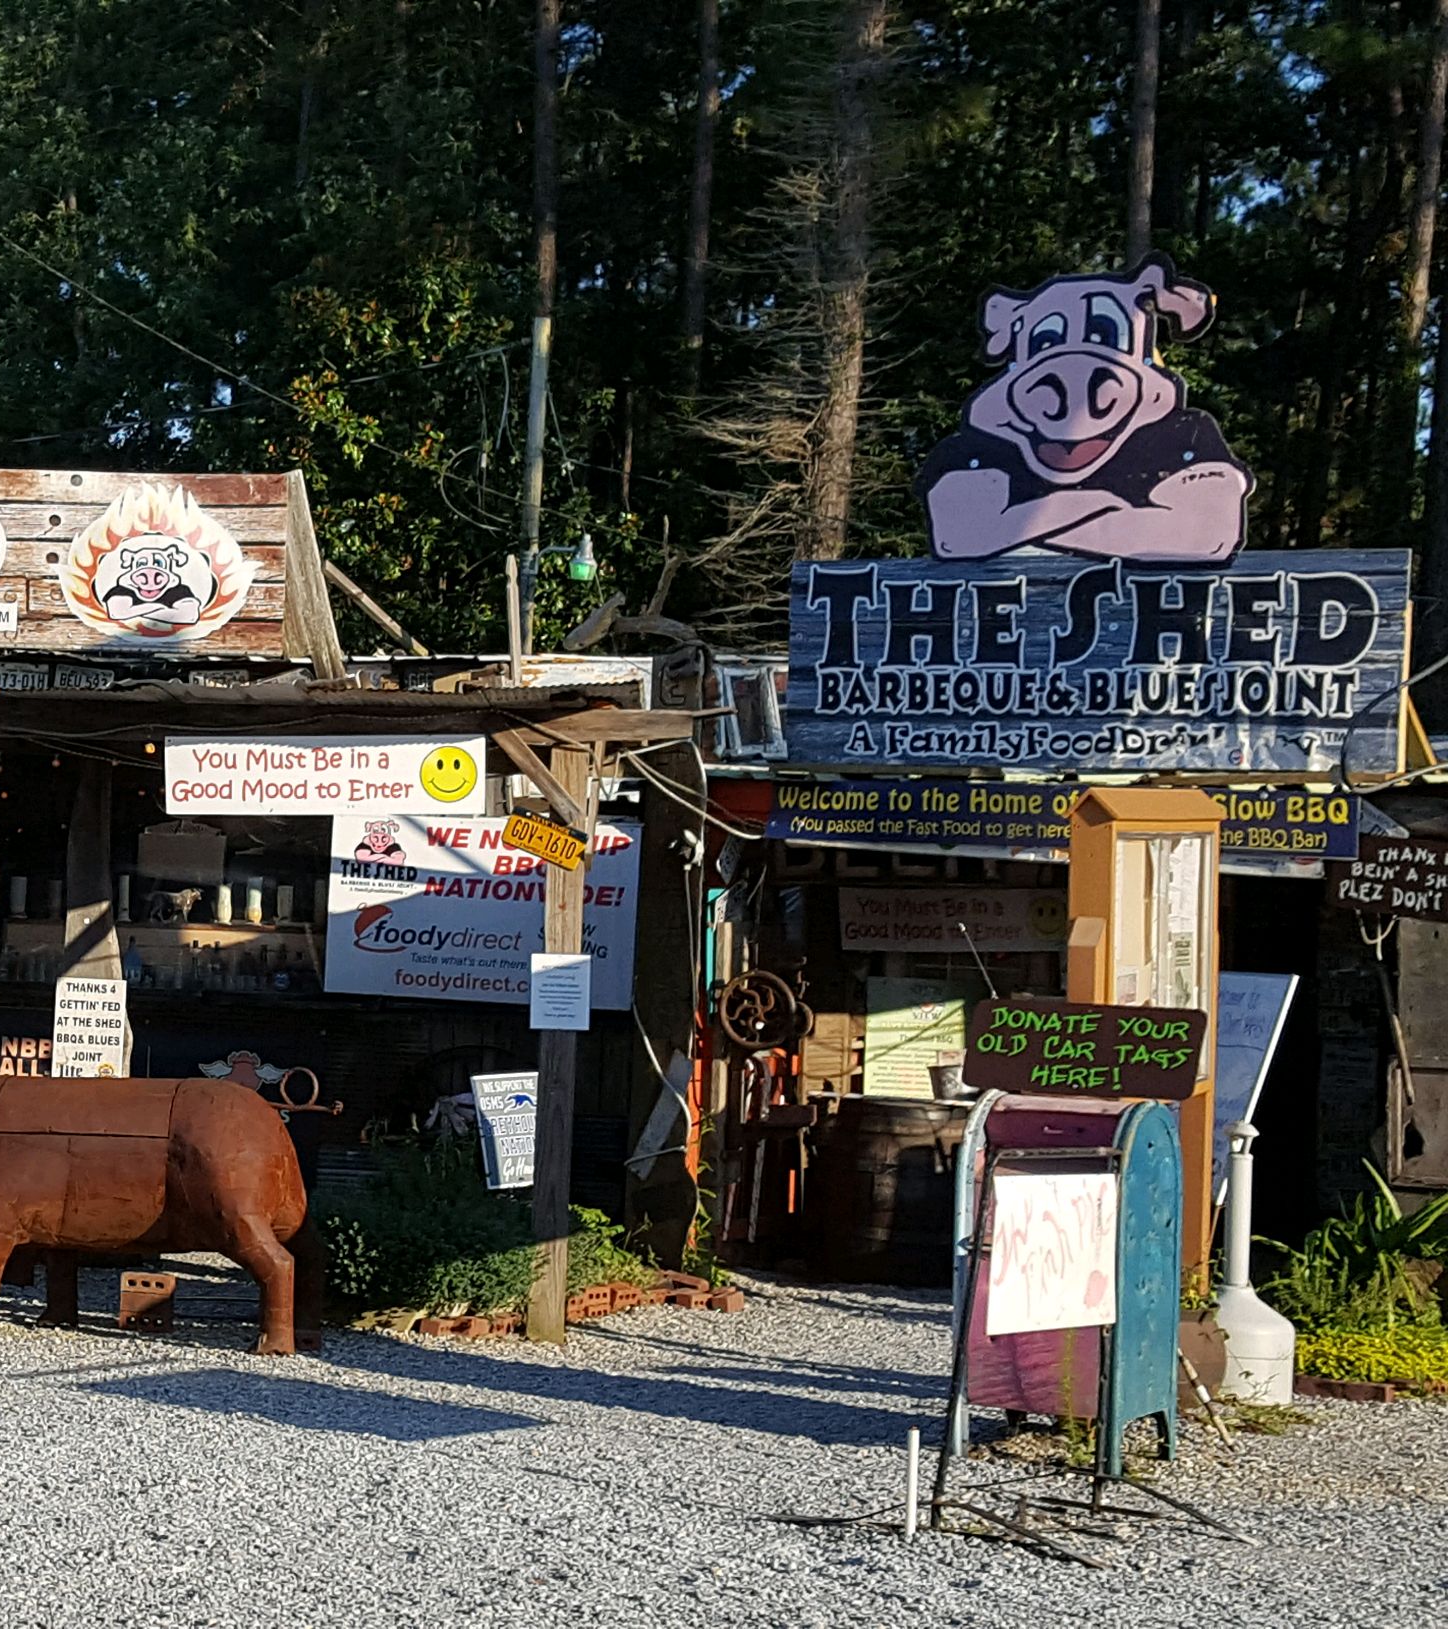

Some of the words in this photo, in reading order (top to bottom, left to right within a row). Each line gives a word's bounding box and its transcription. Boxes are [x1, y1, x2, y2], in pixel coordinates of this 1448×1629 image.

[808, 563, 1027, 670] THE
[1050, 558, 1379, 670] SHED
[816, 670, 1039, 716] BARBEQUE
[1044, 670, 1080, 716] &
[1083, 668, 1219, 717] BLUES
[1216, 666, 1360, 717] JOINT
[844, 721, 878, 755] A
[192, 748, 237, 773] You
[245, 748, 307, 772] Must
[311, 747, 343, 772] Be
[350, 748, 370, 770] in
[377, 755, 390, 770] a
[171, 779, 233, 802] Good
[241, 779, 309, 803] Mood
[315, 781, 342, 800] to
[347, 779, 414, 802] Enter
[778, 786, 880, 811] Welcome
[887, 788, 913, 811] to
[921, 788, 960, 813] the
[969, 788, 1043, 814] Home
[1212, 793, 1277, 820] Slow
[1287, 796, 1350, 824] BBQ
[426, 827, 471, 848] WE
[826, 816, 875, 834] passed
[879, 817, 904, 834] the
[907, 817, 939, 836] Fast
[943, 819, 982, 837] Food
[985, 822, 1005, 837] to
[1006, 822, 1034, 839] get
[1247, 827, 1289, 848] BBQ
[341, 859, 371, 878] THE
[374, 861, 418, 882] SHED
[1406, 868, 1419, 882] A
[857, 896, 890, 916] You
[1338, 879, 1385, 903] PLEZ
[1391, 886, 1443, 912] DON'T
[373, 919, 523, 952] foodydirect
[845, 921, 889, 940] Good
[410, 952, 438, 965] Taste
[441, 954, 476, 968] what's
[479, 957, 497, 968] out
[66, 982, 108, 994] THANKS
[109, 985, 117, 994] 4
[59, 999, 100, 1011] GETTIN'
[102, 1001, 121, 1012] FED
[56, 1016, 70, 1027] AT
[72, 1017, 92, 1028] THE
[95, 1018, 122, 1029] SHED
[990, 1007, 1103, 1034] DONATE
[1117, 1016, 1191, 1041] YOUR
[88, 1035, 121, 1046] BLUES
[976, 1033, 1028, 1057] OLD
[1043, 1035, 1097, 1061] CAR
[1113, 1044, 1194, 1069] TAGS
[71, 1051, 104, 1062] JOINT
[1030, 1064, 1122, 1090] HERE!
